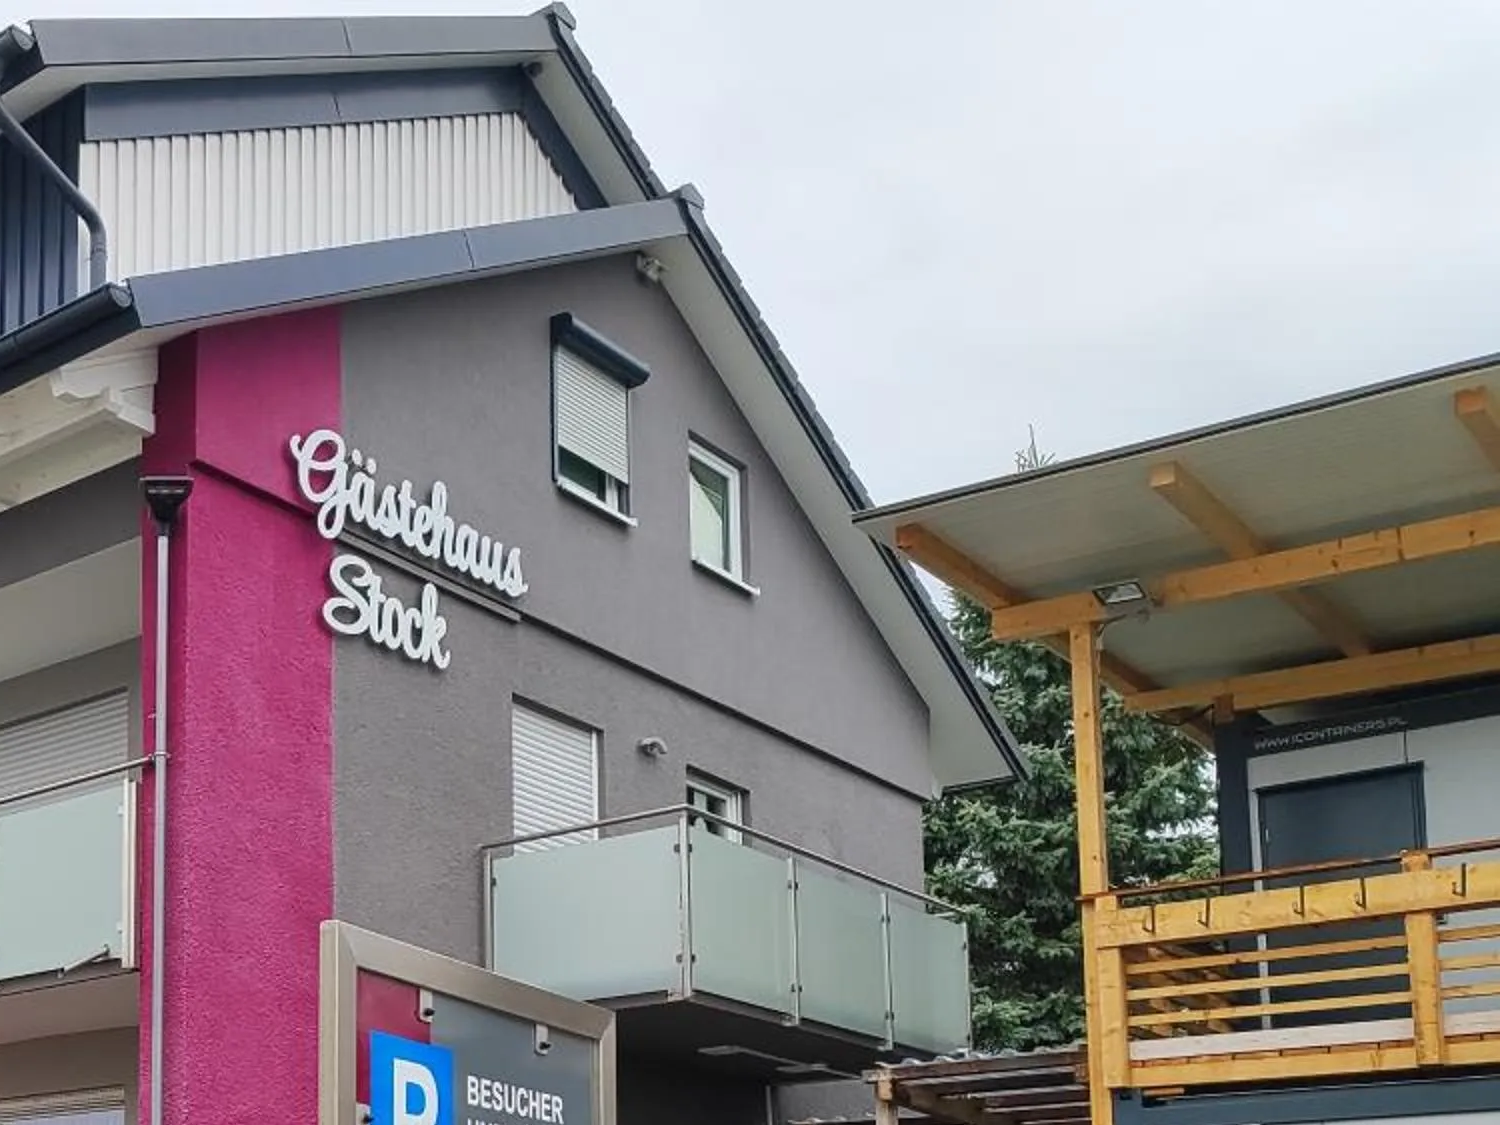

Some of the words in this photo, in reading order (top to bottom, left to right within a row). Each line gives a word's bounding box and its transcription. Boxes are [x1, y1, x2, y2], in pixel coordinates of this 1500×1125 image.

[289, 429, 529, 598] Gästehaus
[322, 554, 450, 669] Stock
[466, 1074, 565, 1125] BESUCHER
